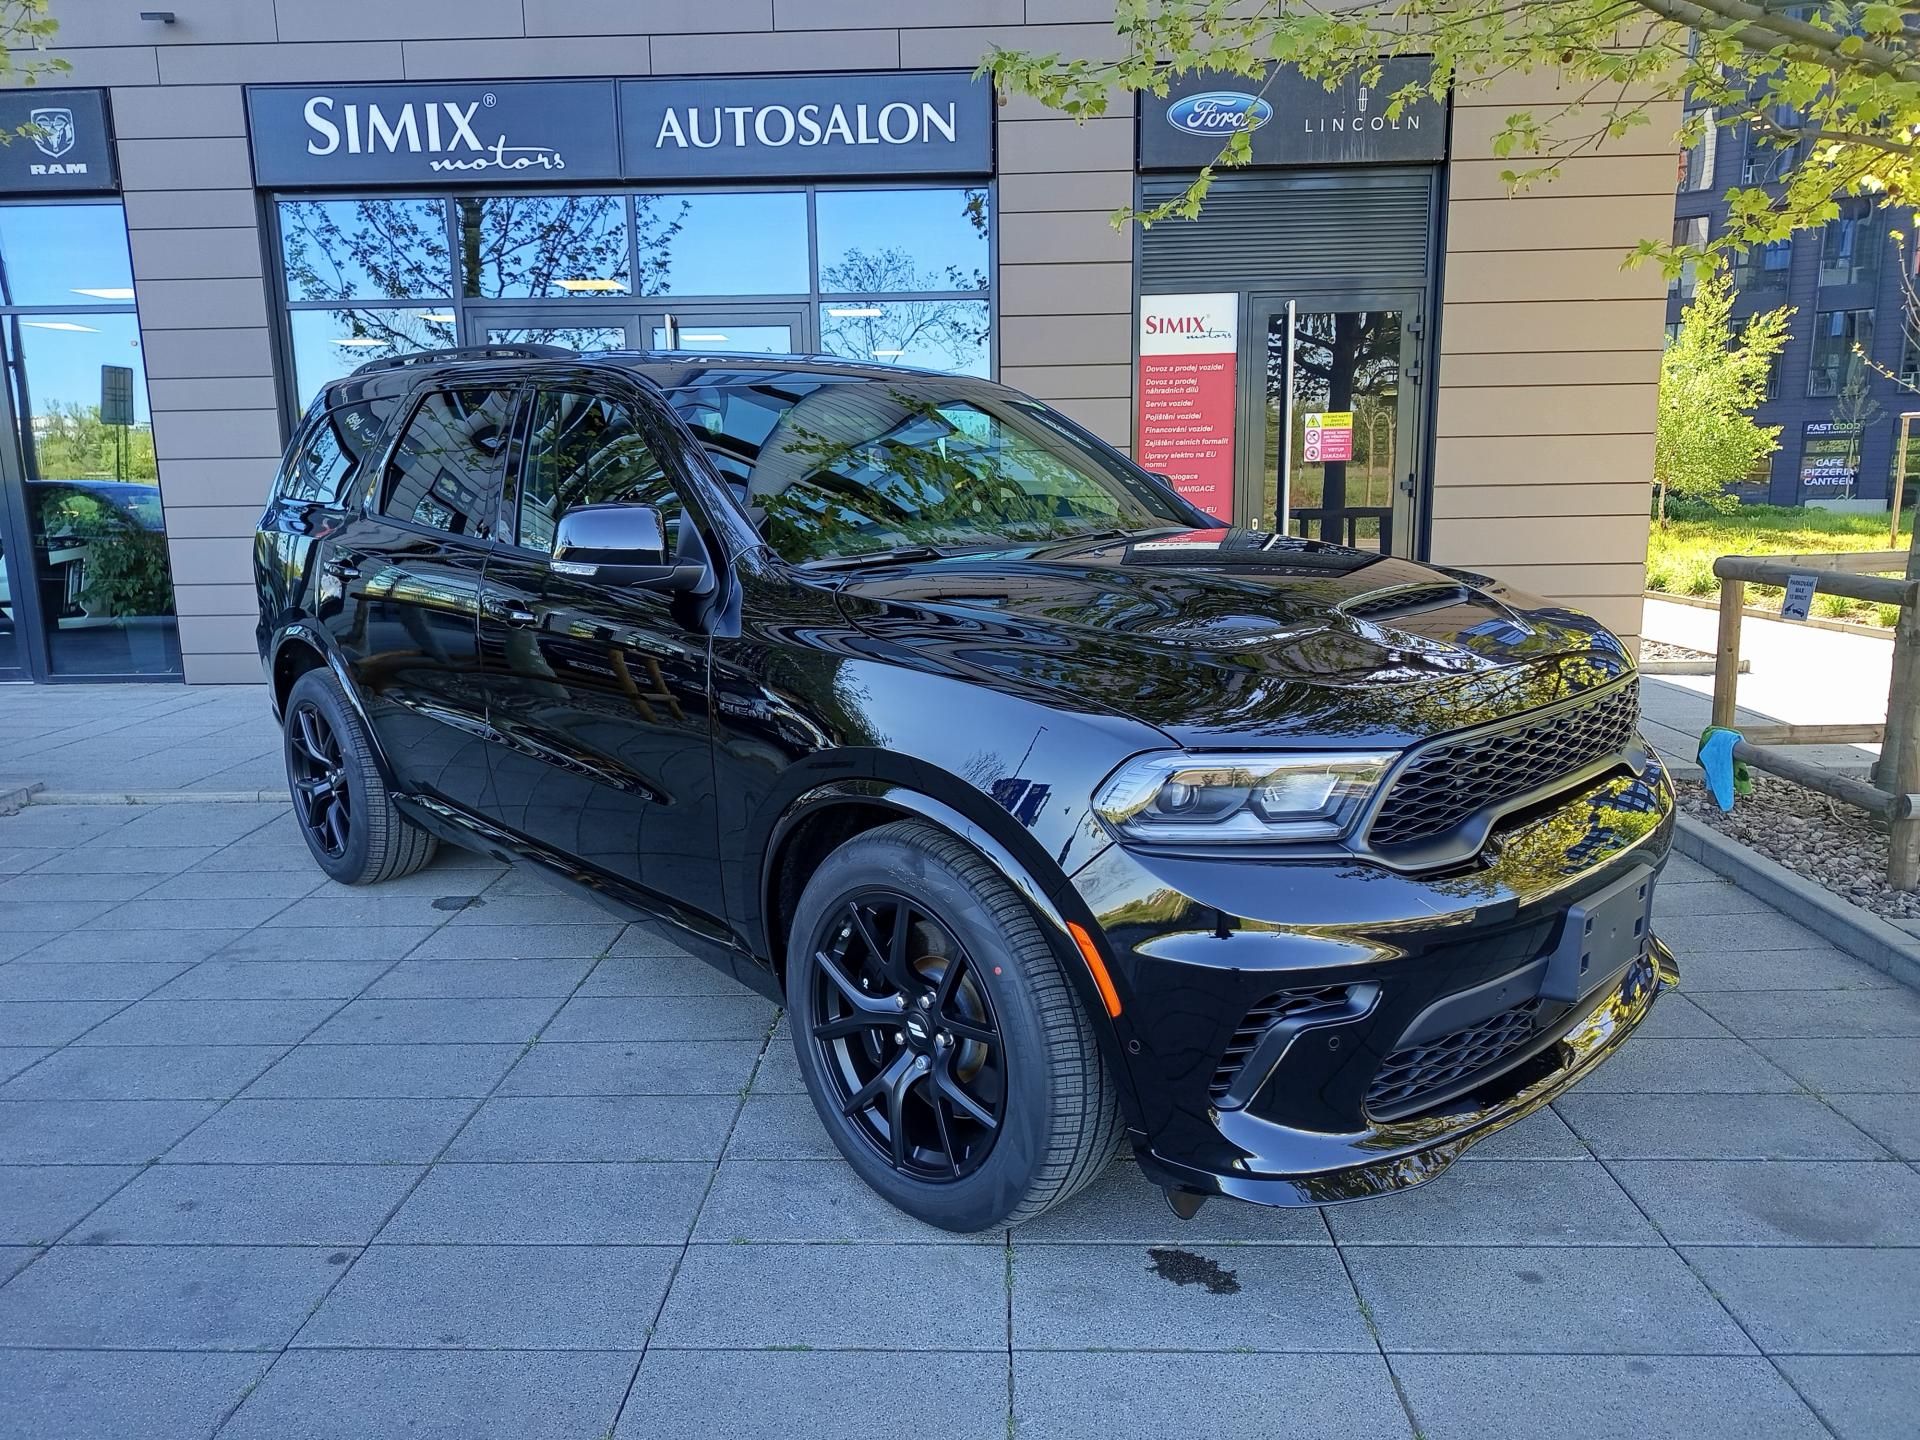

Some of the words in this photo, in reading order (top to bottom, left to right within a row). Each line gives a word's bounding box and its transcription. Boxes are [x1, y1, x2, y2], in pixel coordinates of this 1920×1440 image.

[656, 102, 956, 148] AUTOSALON
[1305, 115, 1420, 132] LINCOLN
[430, 135, 565, 171] motors
[30, 163, 87, 175] RAM
[1145, 315, 1205, 335] SIMIX
[1186, 327, 1232, 340] motors
[1146, 365, 1167, 373] Dovoz
[1175, 364, 1198, 373] prodej
[1200, 363, 1224, 371] vozidel
[1146, 378, 1167, 386] Dovoz
[1175, 378, 1197, 386] prodej
[1145, 400, 1167, 408] Servis
[1145, 413, 1175, 422] Pojištění
[1177, 412, 1201, 420] vozidel
[1145, 426, 1187, 434] Financování
[1189, 425, 1213, 433] vozidel
[1176, 438, 1200, 446] celních
[1816, 459, 1844, 467] CAFE
[1804, 468, 1855, 476] PIZZERIA
[1804, 477, 1854, 486] CANTEEN
[1178, 485, 1215, 493] NAVIGACE
